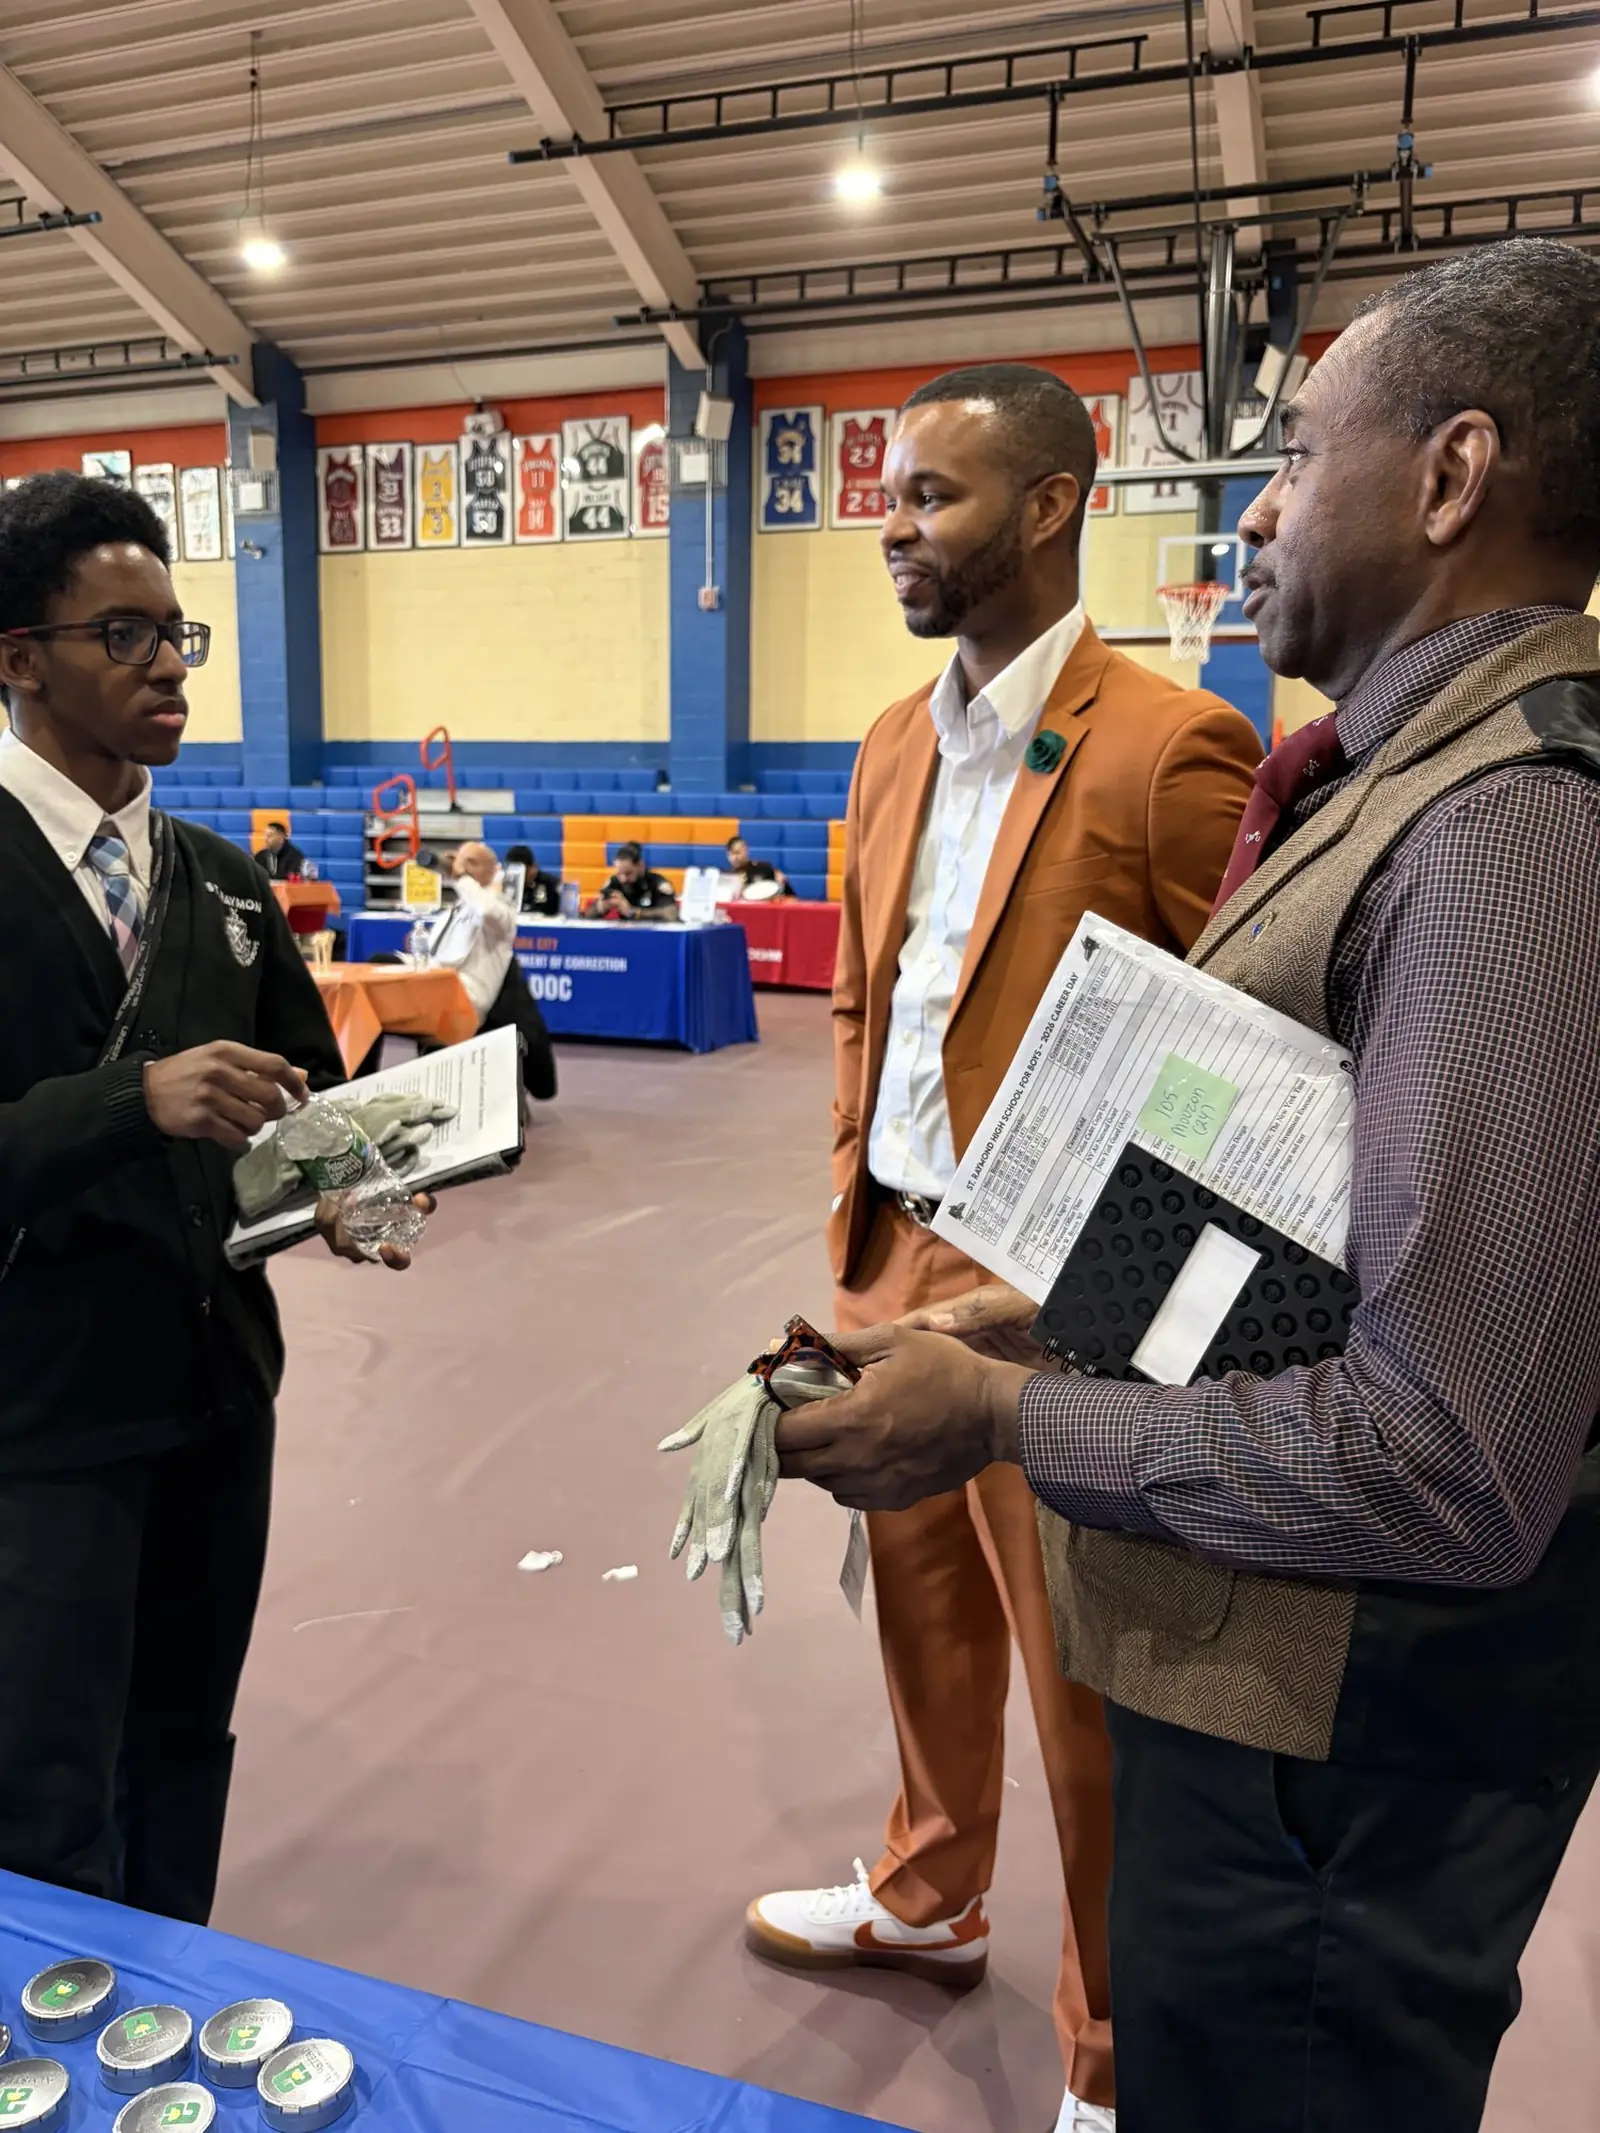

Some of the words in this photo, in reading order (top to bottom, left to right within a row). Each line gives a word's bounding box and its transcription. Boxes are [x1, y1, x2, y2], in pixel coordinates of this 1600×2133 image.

[774, 487, 805, 514] 34
[845, 491, 881, 514] 24
[378, 516, 402, 539] 33
[472, 510, 498, 534] 50
[583, 507, 611, 530] 44
[536, 937, 559, 951] CITY
[548, 954, 563, 969] OF
[563, 955, 628, 972] CORRECTION
[529, 973, 573, 1002] DOC
[1065, 971, 1080, 990] DAY
[1049, 988, 1072, 1022] CAREER
[1039, 1021, 1055, 1043] 2026
[1048, 1027, 1069, 1059] Gymnasium
[1066, 1004, 1080, 1024] Career
[1026, 1048, 1042, 1071] BOYS
[1018, 1070, 1031, 1088] FOR
[1000, 1087, 1023, 1121] SCHOOL
[1153, 1088, 1182, 1119] 105
[990, 1120, 1006, 1142] HIGH
[1075, 1139, 1088, 1156] Police
[1083, 1124, 1096, 1140] Cadet
[1091, 1110, 1104, 1127] Corps
[1098, 1099, 1109, 1112] Unit
[1085, 1151, 1095, 1163] NY
[1090, 1143, 1100, 1153] Air
[1095, 1122, 1110, 1144] National
[1105, 1106, 1118, 1124] Guard
[1189, 1102, 1220, 1138] (24)
[990, 1158, 1001, 1173] Room
[1010, 1112, 1026, 1135] Speaker
[1096, 1156, 1106, 1169] New
[1102, 1143, 1113, 1157] York
[1108, 1127, 1121, 1144] Guard
[1116, 1108, 1133, 1130] (Army)
[1215, 1162, 1225, 1174] and
[1220, 1141, 1237, 1164] Website
[1231, 1123, 1249, 1144] Design
[1240, 1162, 1255, 1181] Senior
[1250, 1150, 1262, 1164] Staff
[1258, 1131, 1274, 1152] Editor,
[1268, 1120, 1280, 1133] The
[1275, 1107, 1287, 1122] New
[1282, 1092, 1297, 1110] York
[1251, 1167, 1268, 1192] Financial
[1264, 1145, 1282, 1169] Advisor
[1278, 1113, 1300, 1145] Investment
[1296, 1086, 1317, 1116] Executive
[970, 1140, 995, 1180] RAYMOND
[1221, 1179, 1230, 1190] and
[1226, 1164, 1239, 1181] Adult
[1234, 1135, 1256, 1167] Psychiatrist
[1256, 1189, 1272, 1210] Digital
[1267, 1170, 1283, 1192] systems
[1279, 1153, 1294, 1173] design
[1289, 1143, 1299, 1154] and
[1295, 1132, 1306, 1144] test
[965, 1178, 976, 1191] ST.
[1265, 1193, 1284, 1219] Mechanic
[1279, 1191, 1301, 1223] Corrections
[1298, 1193, 1317, 1219] Designer
[1315, 1206, 1333, 1230] Director
[1330, 1177, 1351, 1205] Strategic
[1019, 1213, 1036, 1237] Presenter
[1044, 1216, 1060, 1237] Franklin
[1055, 1202, 1068, 1218] Angel
[1048, 1242, 1059, 1256] Chief
[1064, 1210, 1076, 1227] Officer
[1072, 1197, 1083, 1211] Three
[1009, 1240, 1021, 1255] Table
[1055, 1243, 1067, 1260] Arthur
[1067, 1219, 1079, 1236] Brown
